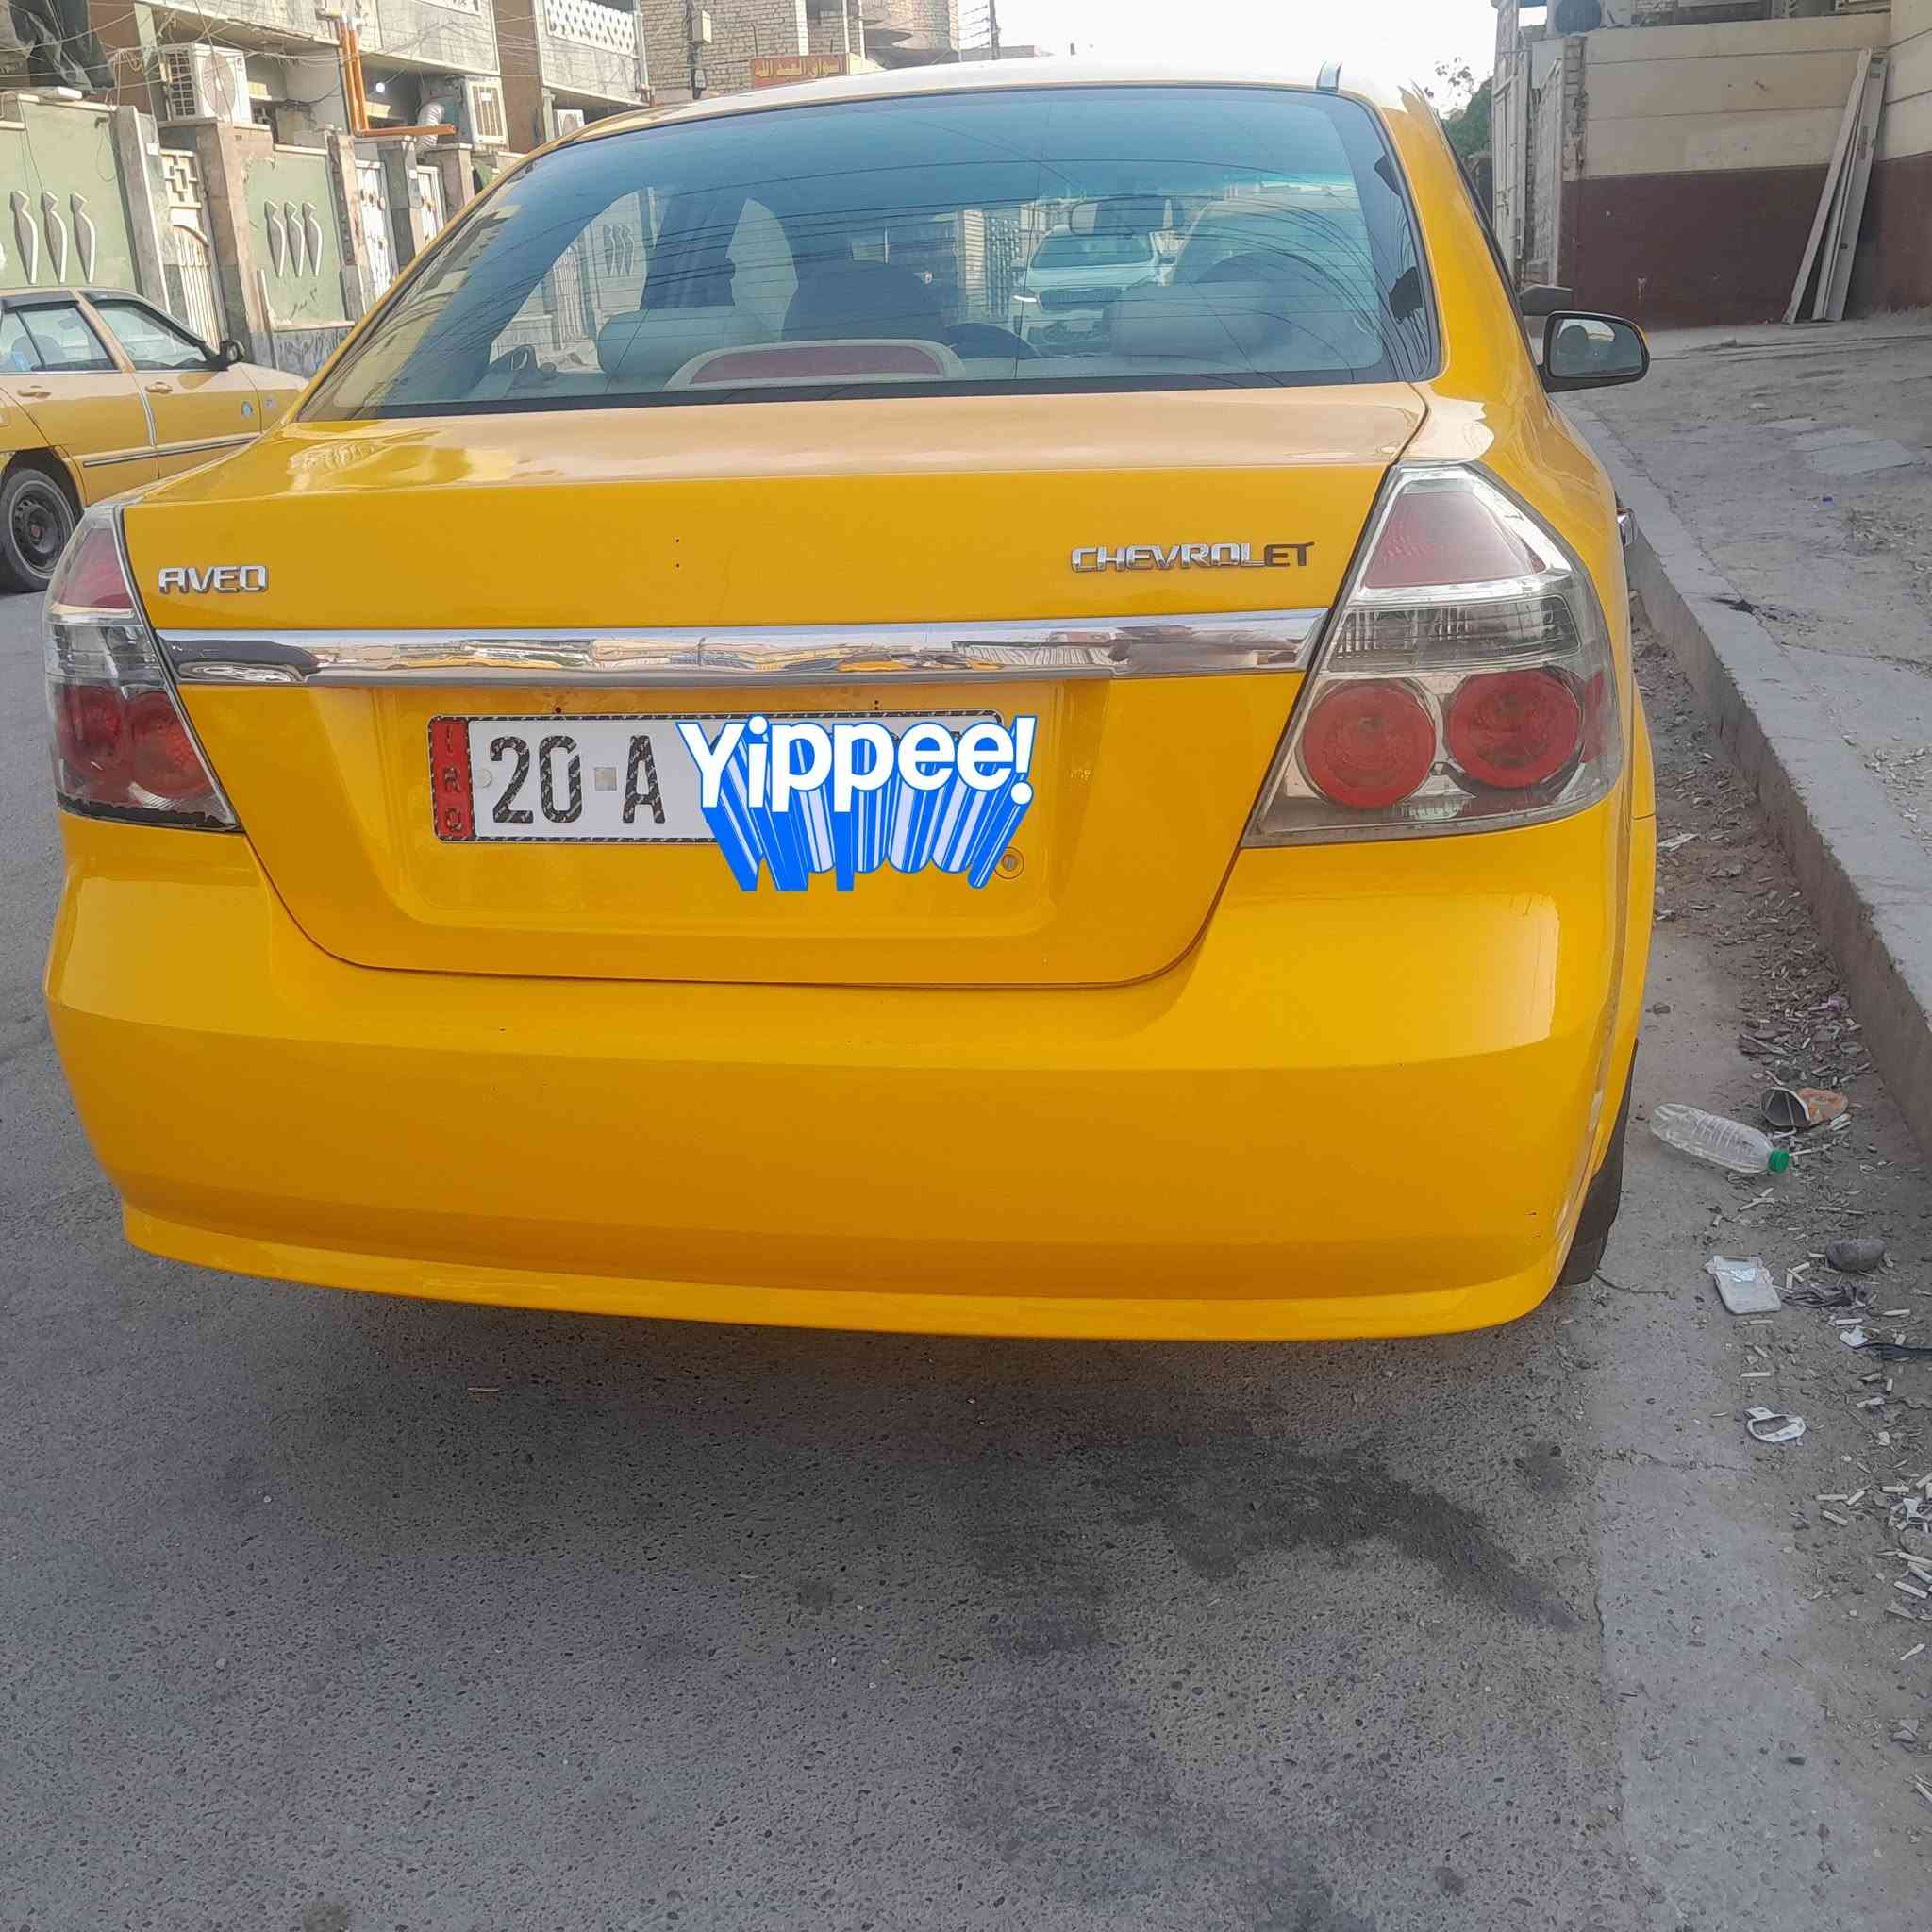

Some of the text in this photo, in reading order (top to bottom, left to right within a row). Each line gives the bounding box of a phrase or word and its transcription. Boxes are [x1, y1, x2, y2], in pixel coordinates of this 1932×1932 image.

[1071, 541, 1315, 573] CHEVROLET
[158, 566, 268, 595] AVEO
[490, 734, 666, 824] 20 A
